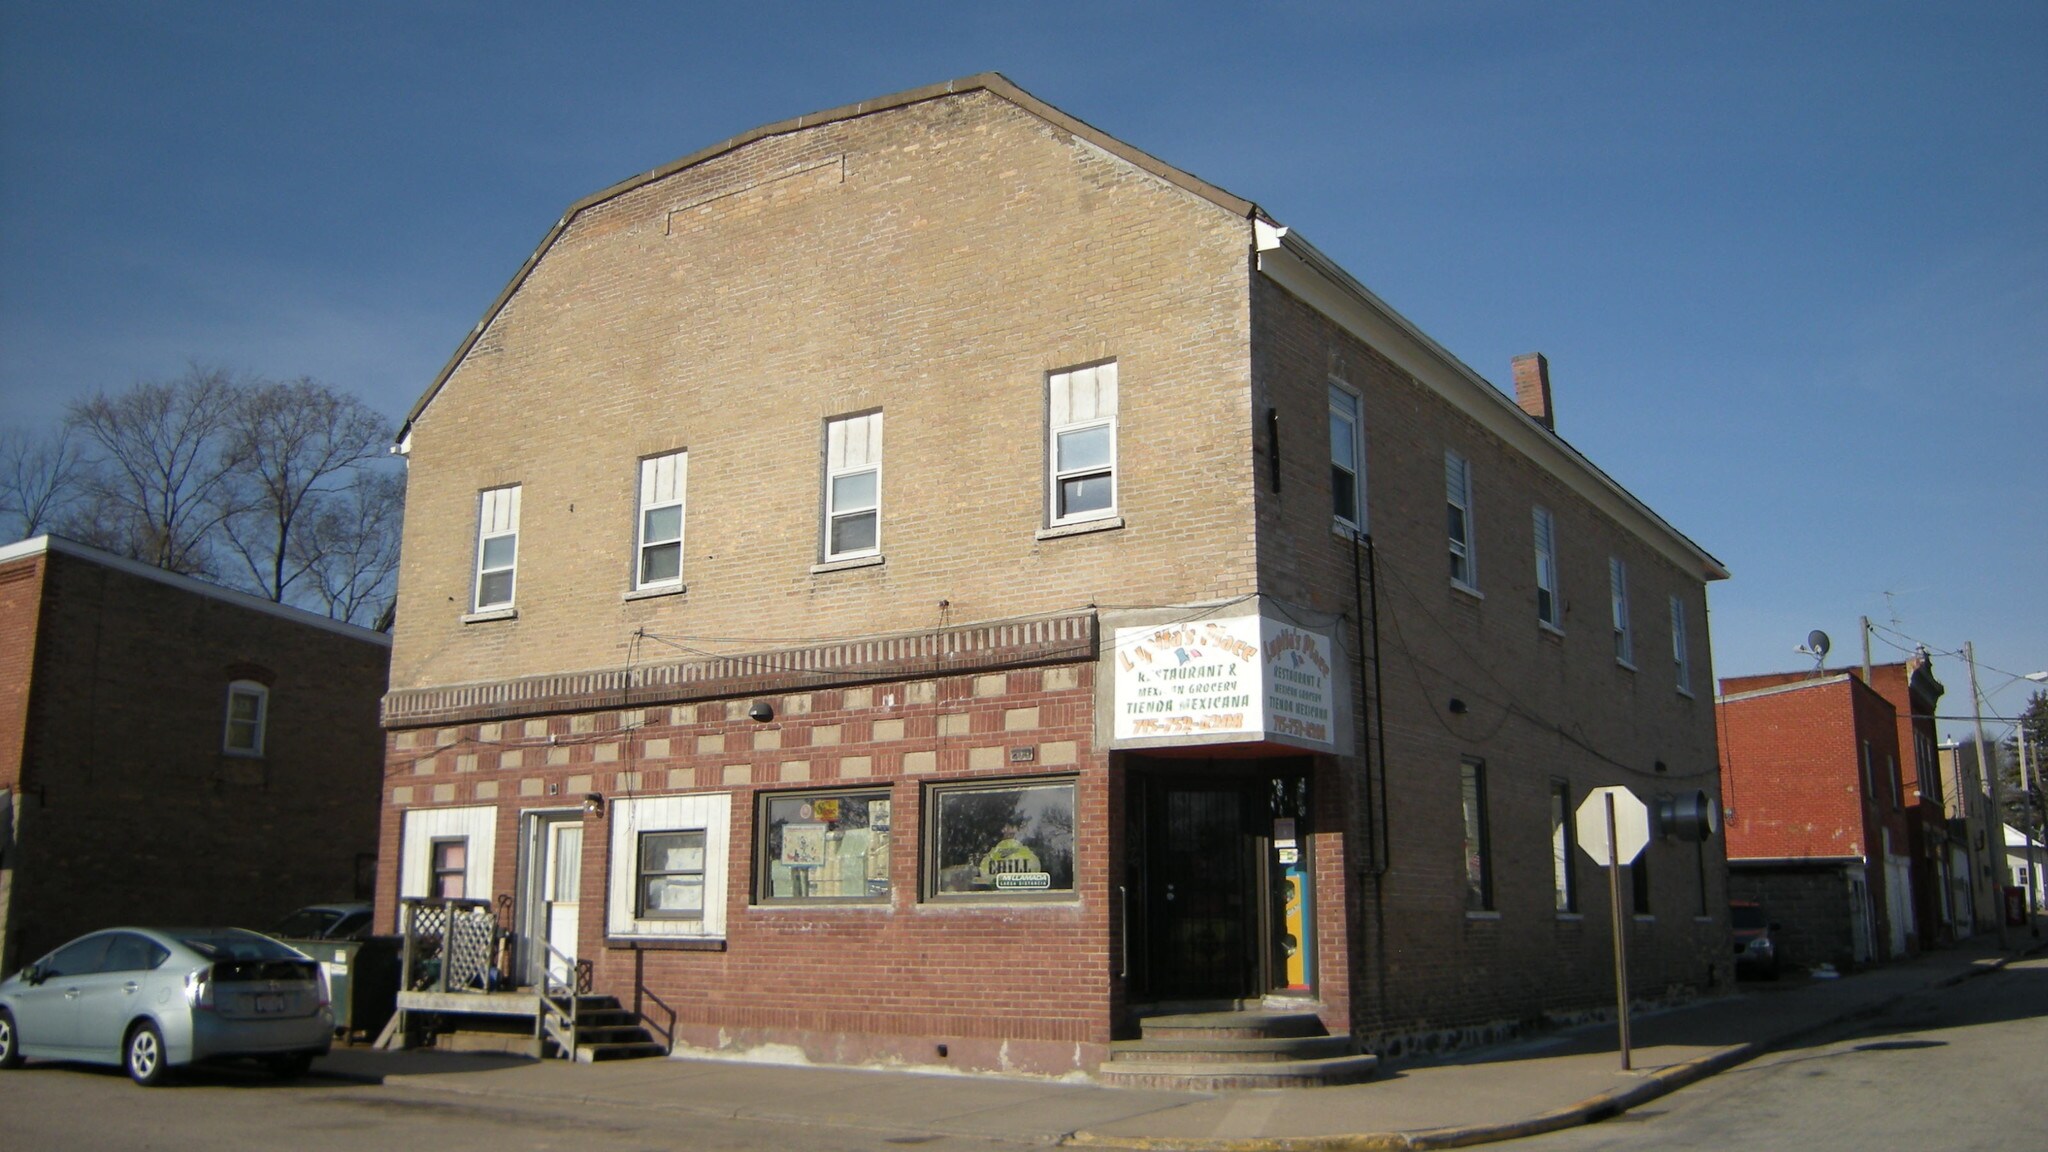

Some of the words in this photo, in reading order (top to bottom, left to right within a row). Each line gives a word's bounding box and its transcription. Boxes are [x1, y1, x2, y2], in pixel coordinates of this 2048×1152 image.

[1138, 664, 1223, 682] RSTAURANT
[1229, 663, 1237, 676] &
[1274, 665, 1315, 686] RESTAURANT
[1138, 685, 1184, 697] MEXN
[1189, 681, 1237, 694] GROCERY
[1274, 684, 1297, 697] MEXICAN
[1299, 687, 1322, 703] GROCERY
[1127, 699, 1173, 714] TIENDA
[1179, 694, 1249, 711] MEXICANA
[1270, 696, 1293, 713] TIENDA
[1296, 701, 1328, 721] MEXICANA
[989, 859, 1032, 875] CHILL
